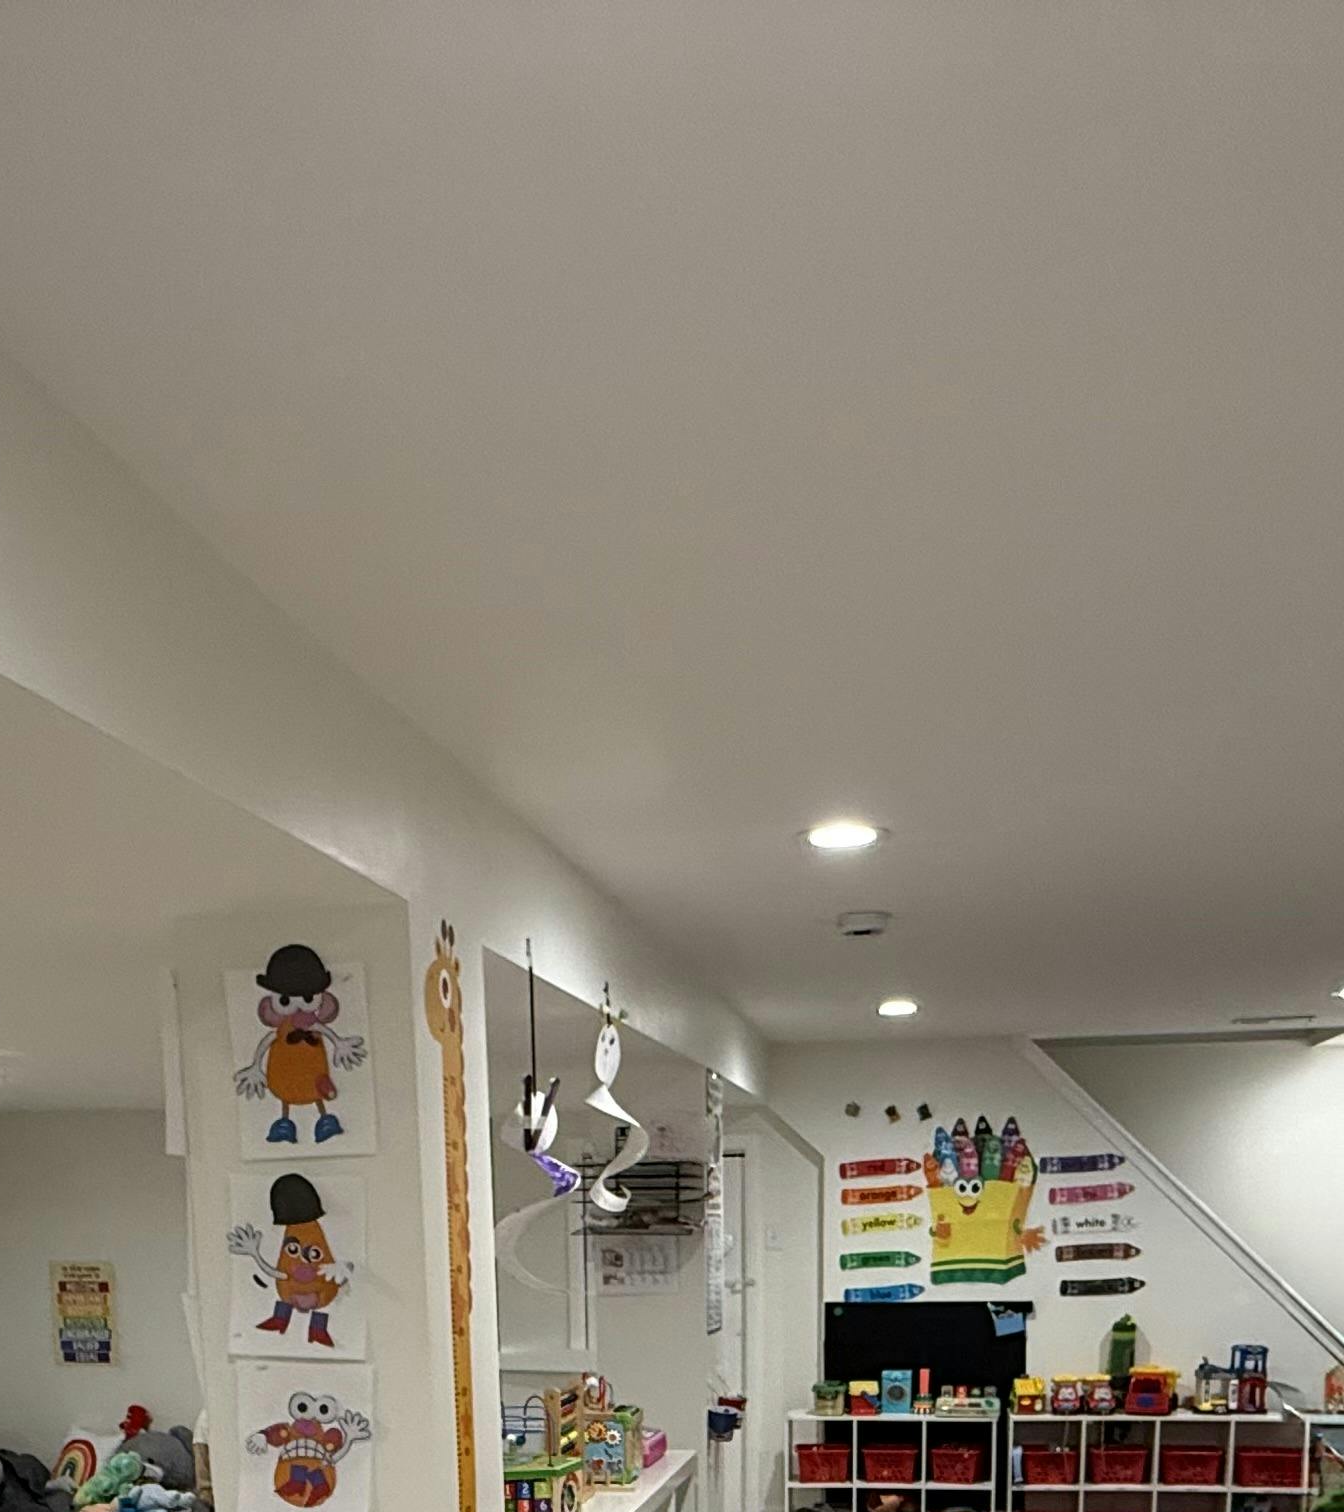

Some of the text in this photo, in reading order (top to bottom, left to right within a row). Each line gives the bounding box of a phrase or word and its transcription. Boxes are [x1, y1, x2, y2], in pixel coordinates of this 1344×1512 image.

[859, 1190, 898, 1201] orange
[861, 1217, 897, 1232] yellow
[1075, 1217, 1106, 1229] white
[522, 1481, 530, 1495] 2
[539, 1500, 548, 1511] 6
